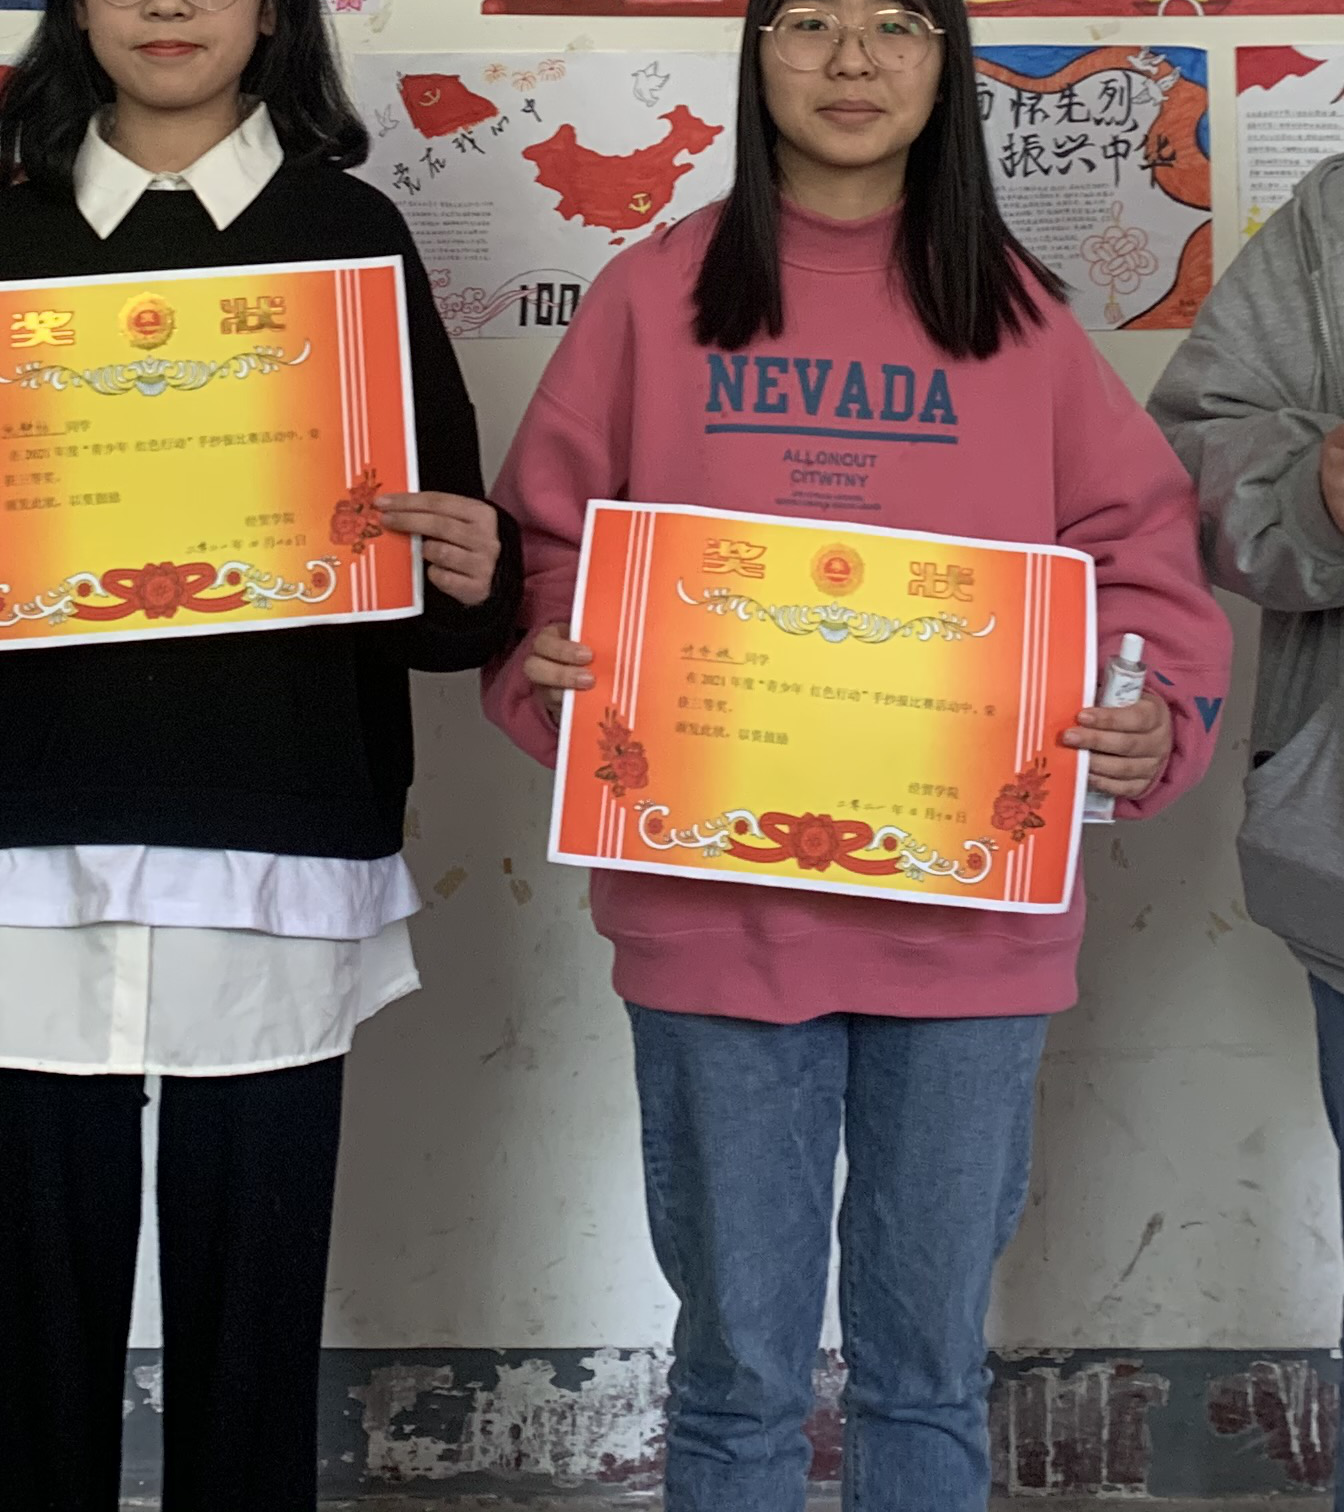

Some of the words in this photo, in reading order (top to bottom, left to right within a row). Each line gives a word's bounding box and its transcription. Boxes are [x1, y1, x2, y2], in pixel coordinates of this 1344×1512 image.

[1000, 132, 1178, 189] 振兴中华
[10, 309, 75, 349] 奖
[220, 295, 286, 335] 状
[519, 282, 581, 328] 100
[704, 354, 959, 426] NEVADA
[702, 538, 768, 580] 奖
[907, 561, 975, 602] 状
